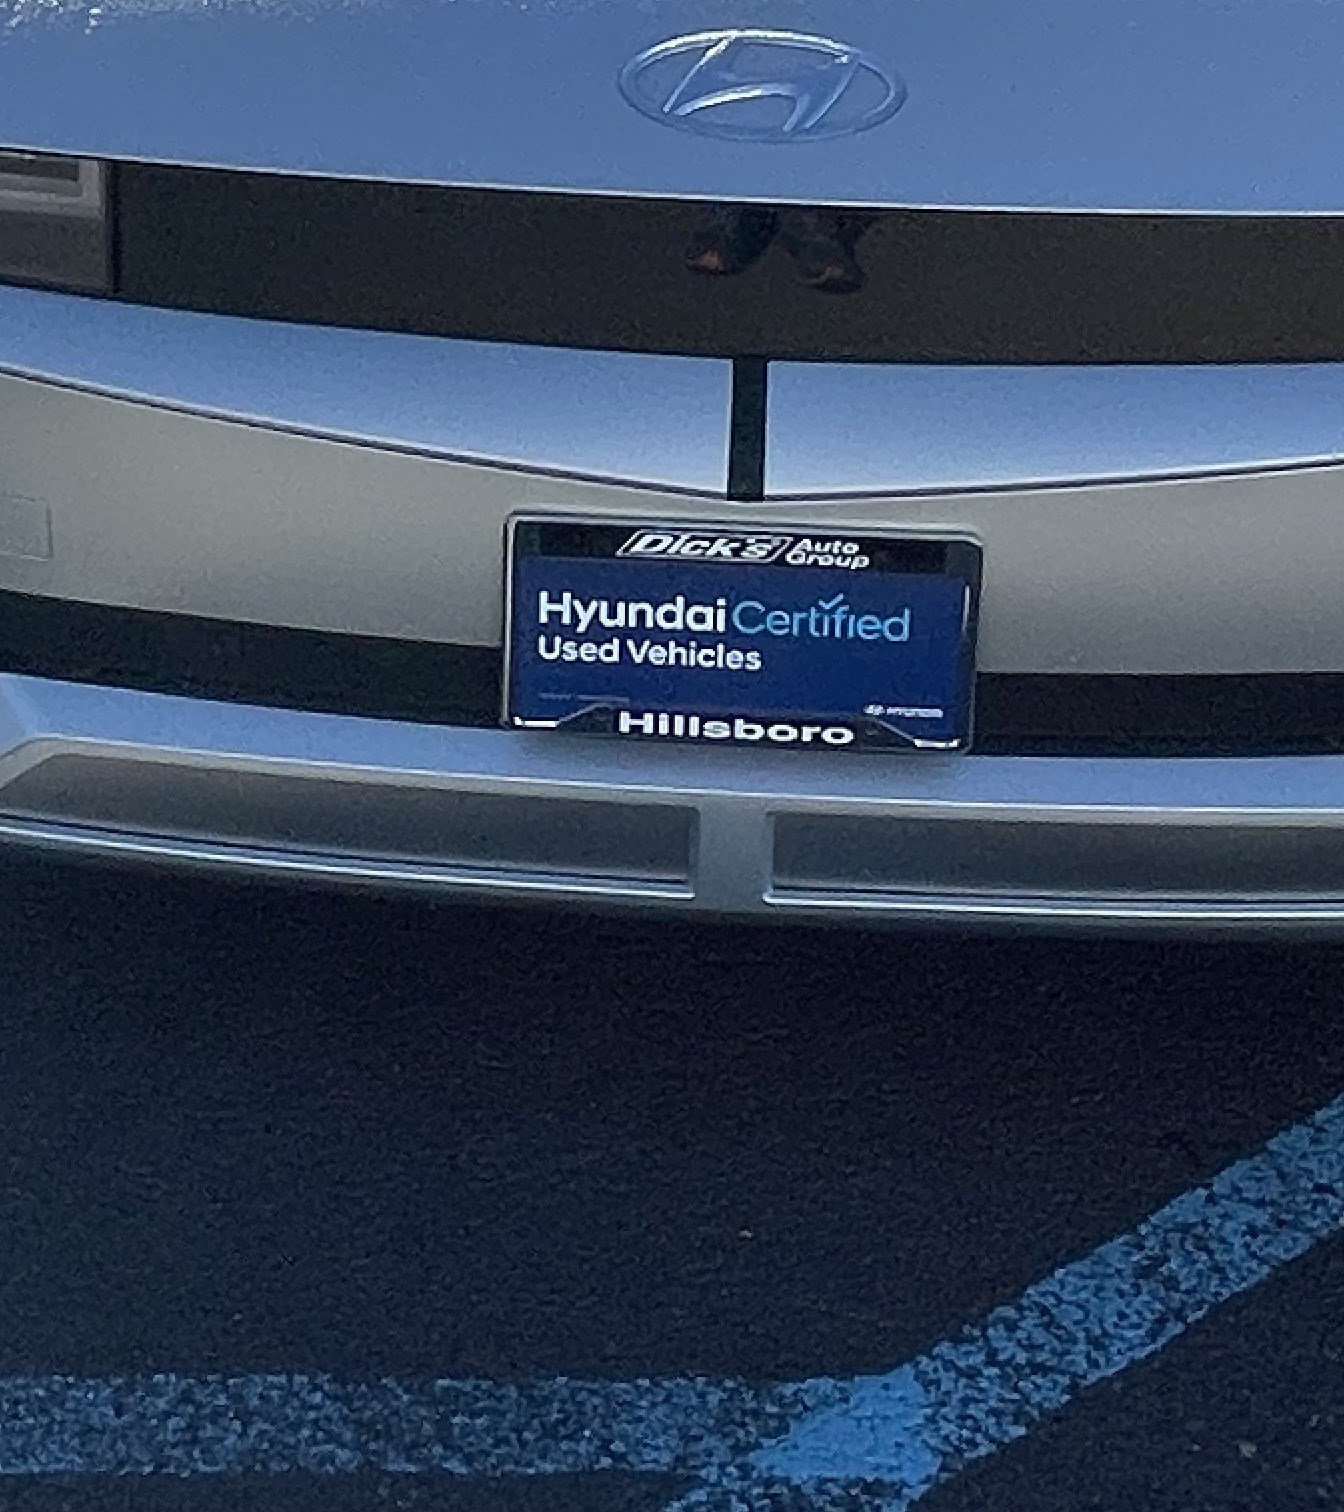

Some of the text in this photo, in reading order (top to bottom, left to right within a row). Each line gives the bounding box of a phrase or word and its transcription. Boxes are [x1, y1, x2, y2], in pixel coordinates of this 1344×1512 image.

[785, 552, 870, 569] Group
[793, 538, 860, 555] Auto
[538, 590, 911, 642] Hyundai Certified
[538, 635, 762, 671] Used Vehicles
[618, 710, 855, 745] Hillsboro
